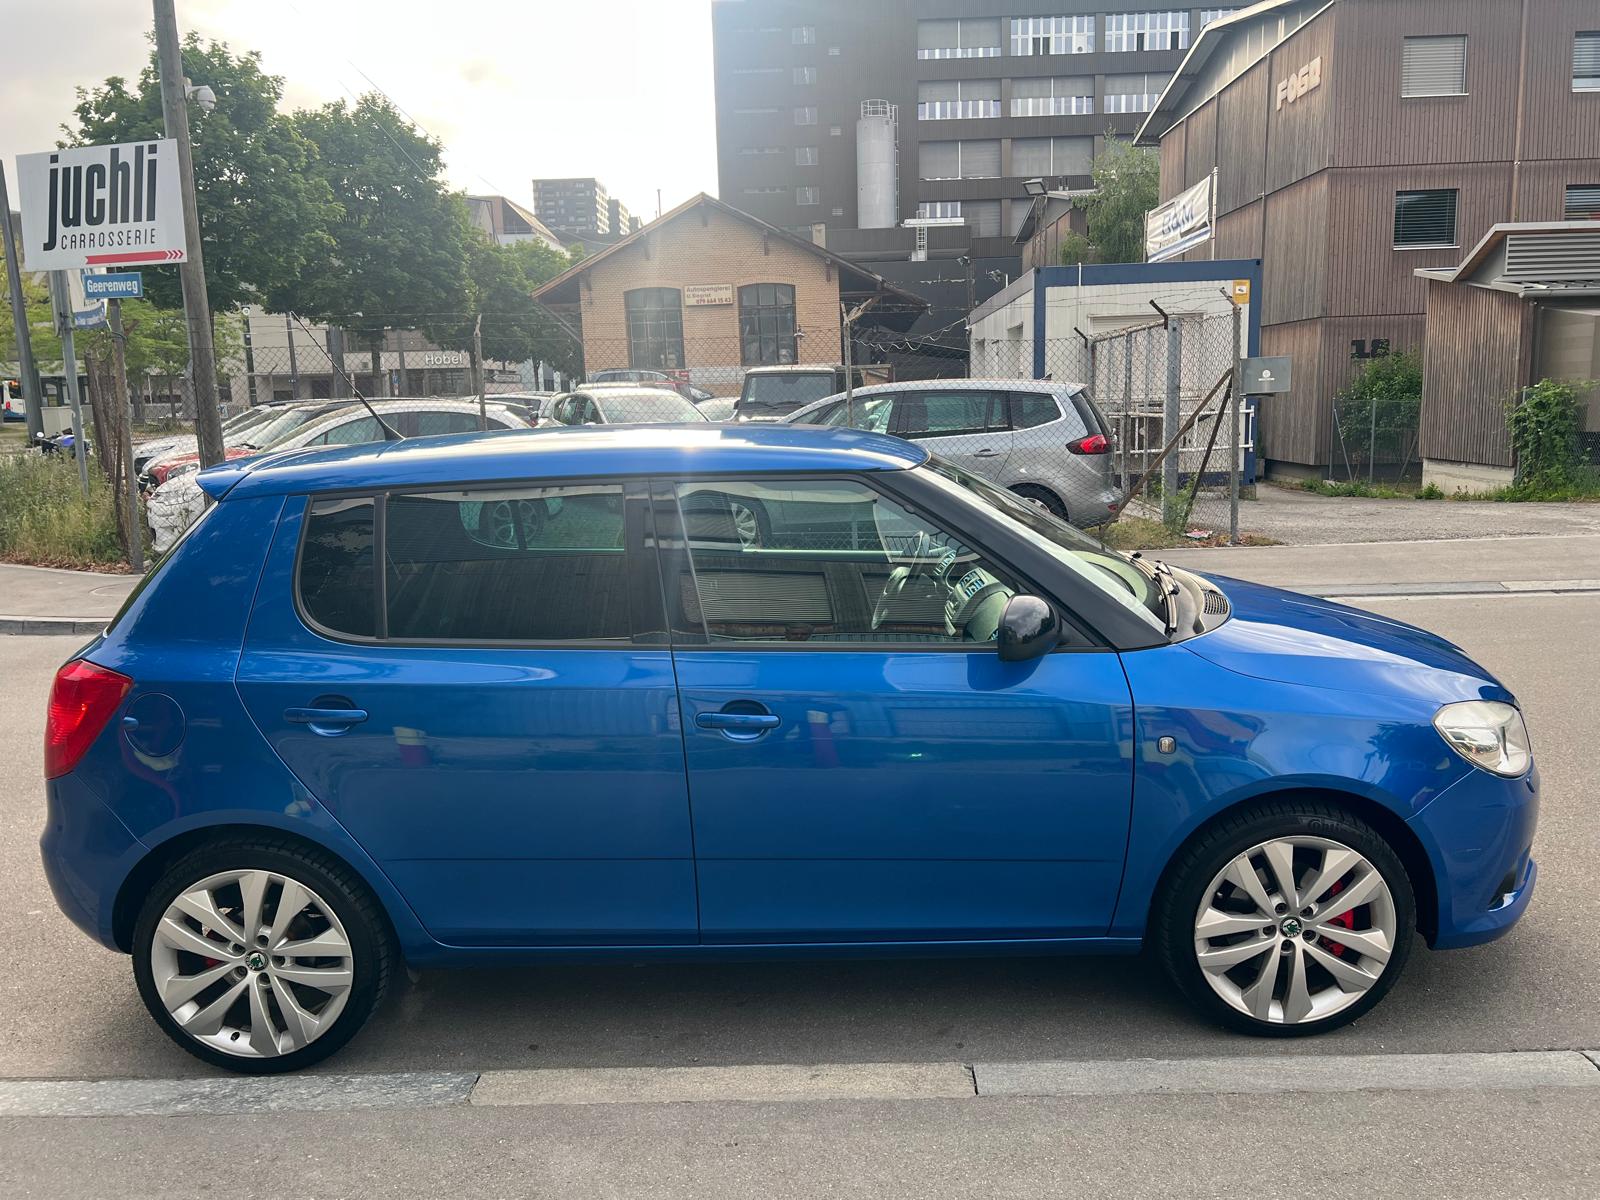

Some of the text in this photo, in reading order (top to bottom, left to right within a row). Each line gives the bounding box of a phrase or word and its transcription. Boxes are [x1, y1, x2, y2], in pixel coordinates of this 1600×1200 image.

[43, 144, 158, 251] juchli
[61, 228, 156, 250] CARROSSERIE
[87, 279, 138, 294] Geerenweg
[425, 353, 462, 364] Hobel
